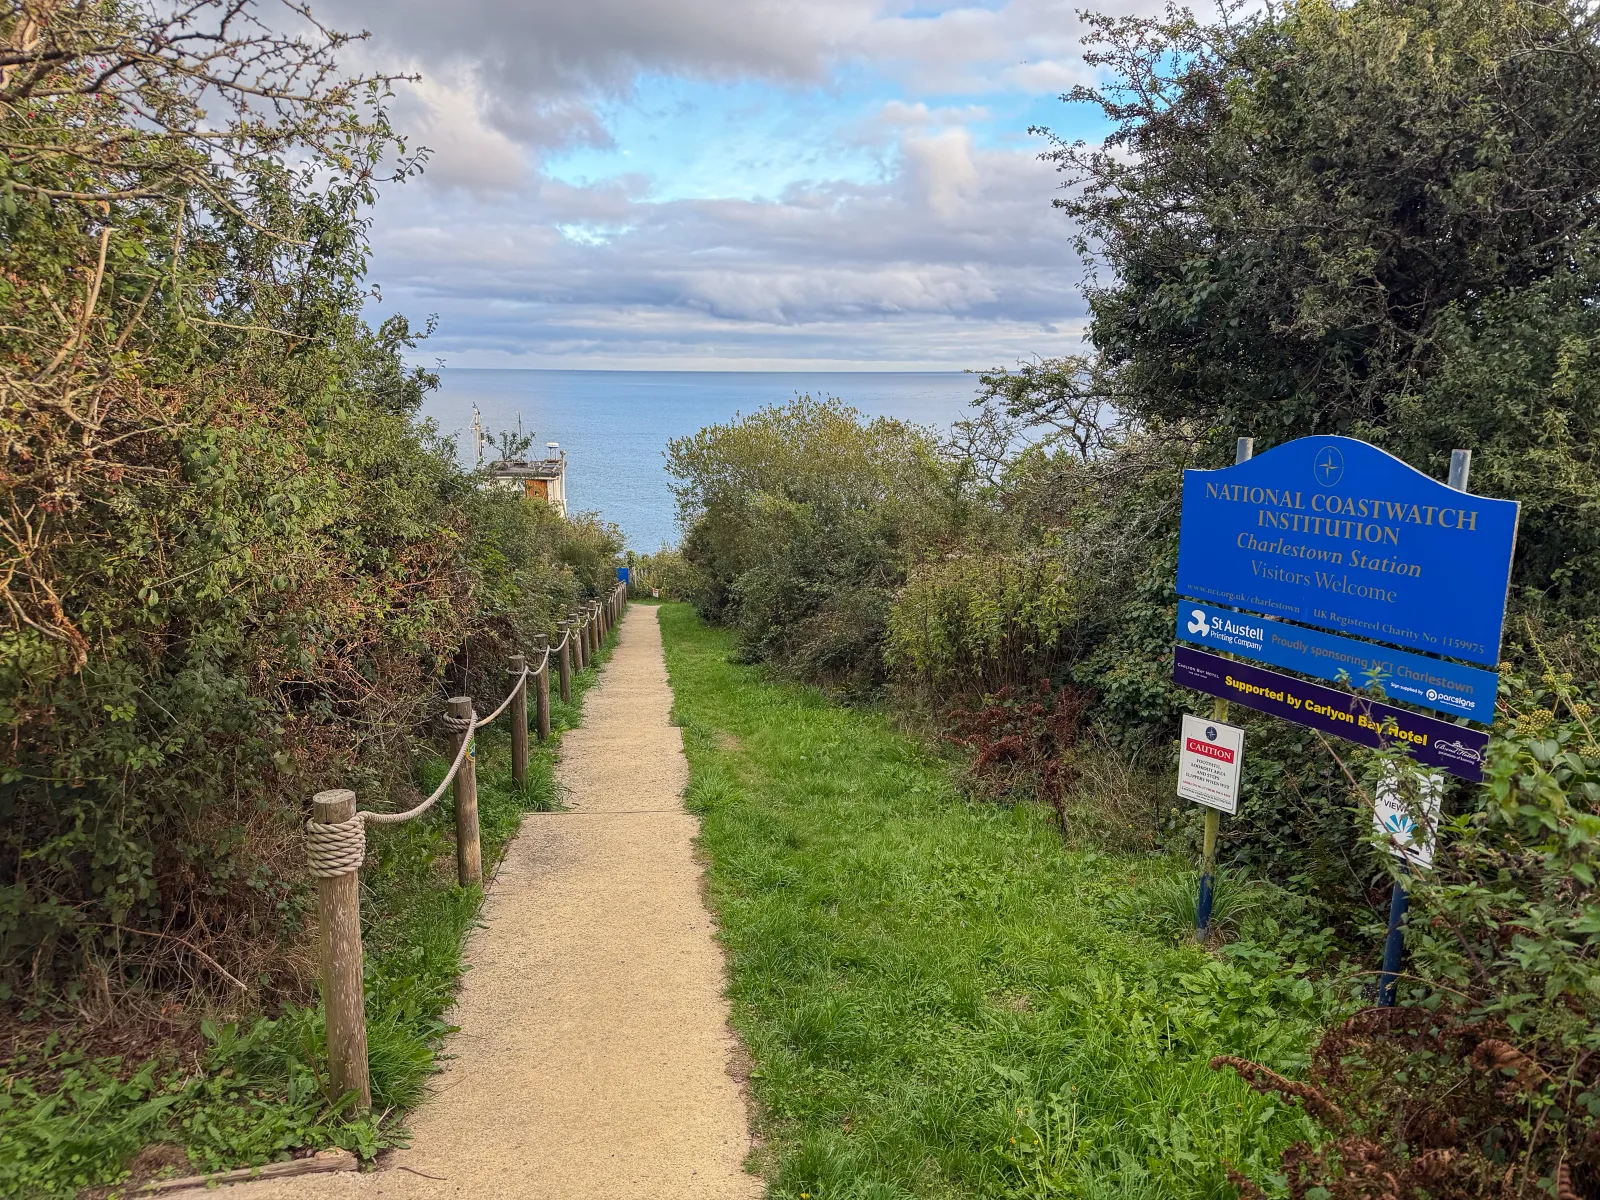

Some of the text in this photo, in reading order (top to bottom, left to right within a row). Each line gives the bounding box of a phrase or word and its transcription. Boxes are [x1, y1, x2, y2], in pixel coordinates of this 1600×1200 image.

[1205, 482, 1478, 531] NATIONAL COASTWATCH
[1257, 509, 1400, 546] INSTITUTION
[1237, 532, 1422, 578] Charlestown Station
[1187, 583, 1300, 613] www.nci.org.uk/charlestown
[1251, 559, 1397, 603] Visitors Welcome
[1210, 629, 1263, 652] Printing Company
[1211, 616, 1264, 641] St Austell
[1313, 608, 1485, 655] UK Registered Charity No 1159975
[1271, 633, 1474, 695] Proudly sponsoring NCI Charlestown
[1225, 675, 1428, 746] Supported by Carlyon Bay Hotel
[1437, 693, 1476, 708] parcsigns
[1189, 741, 1231, 760] CAUTION
